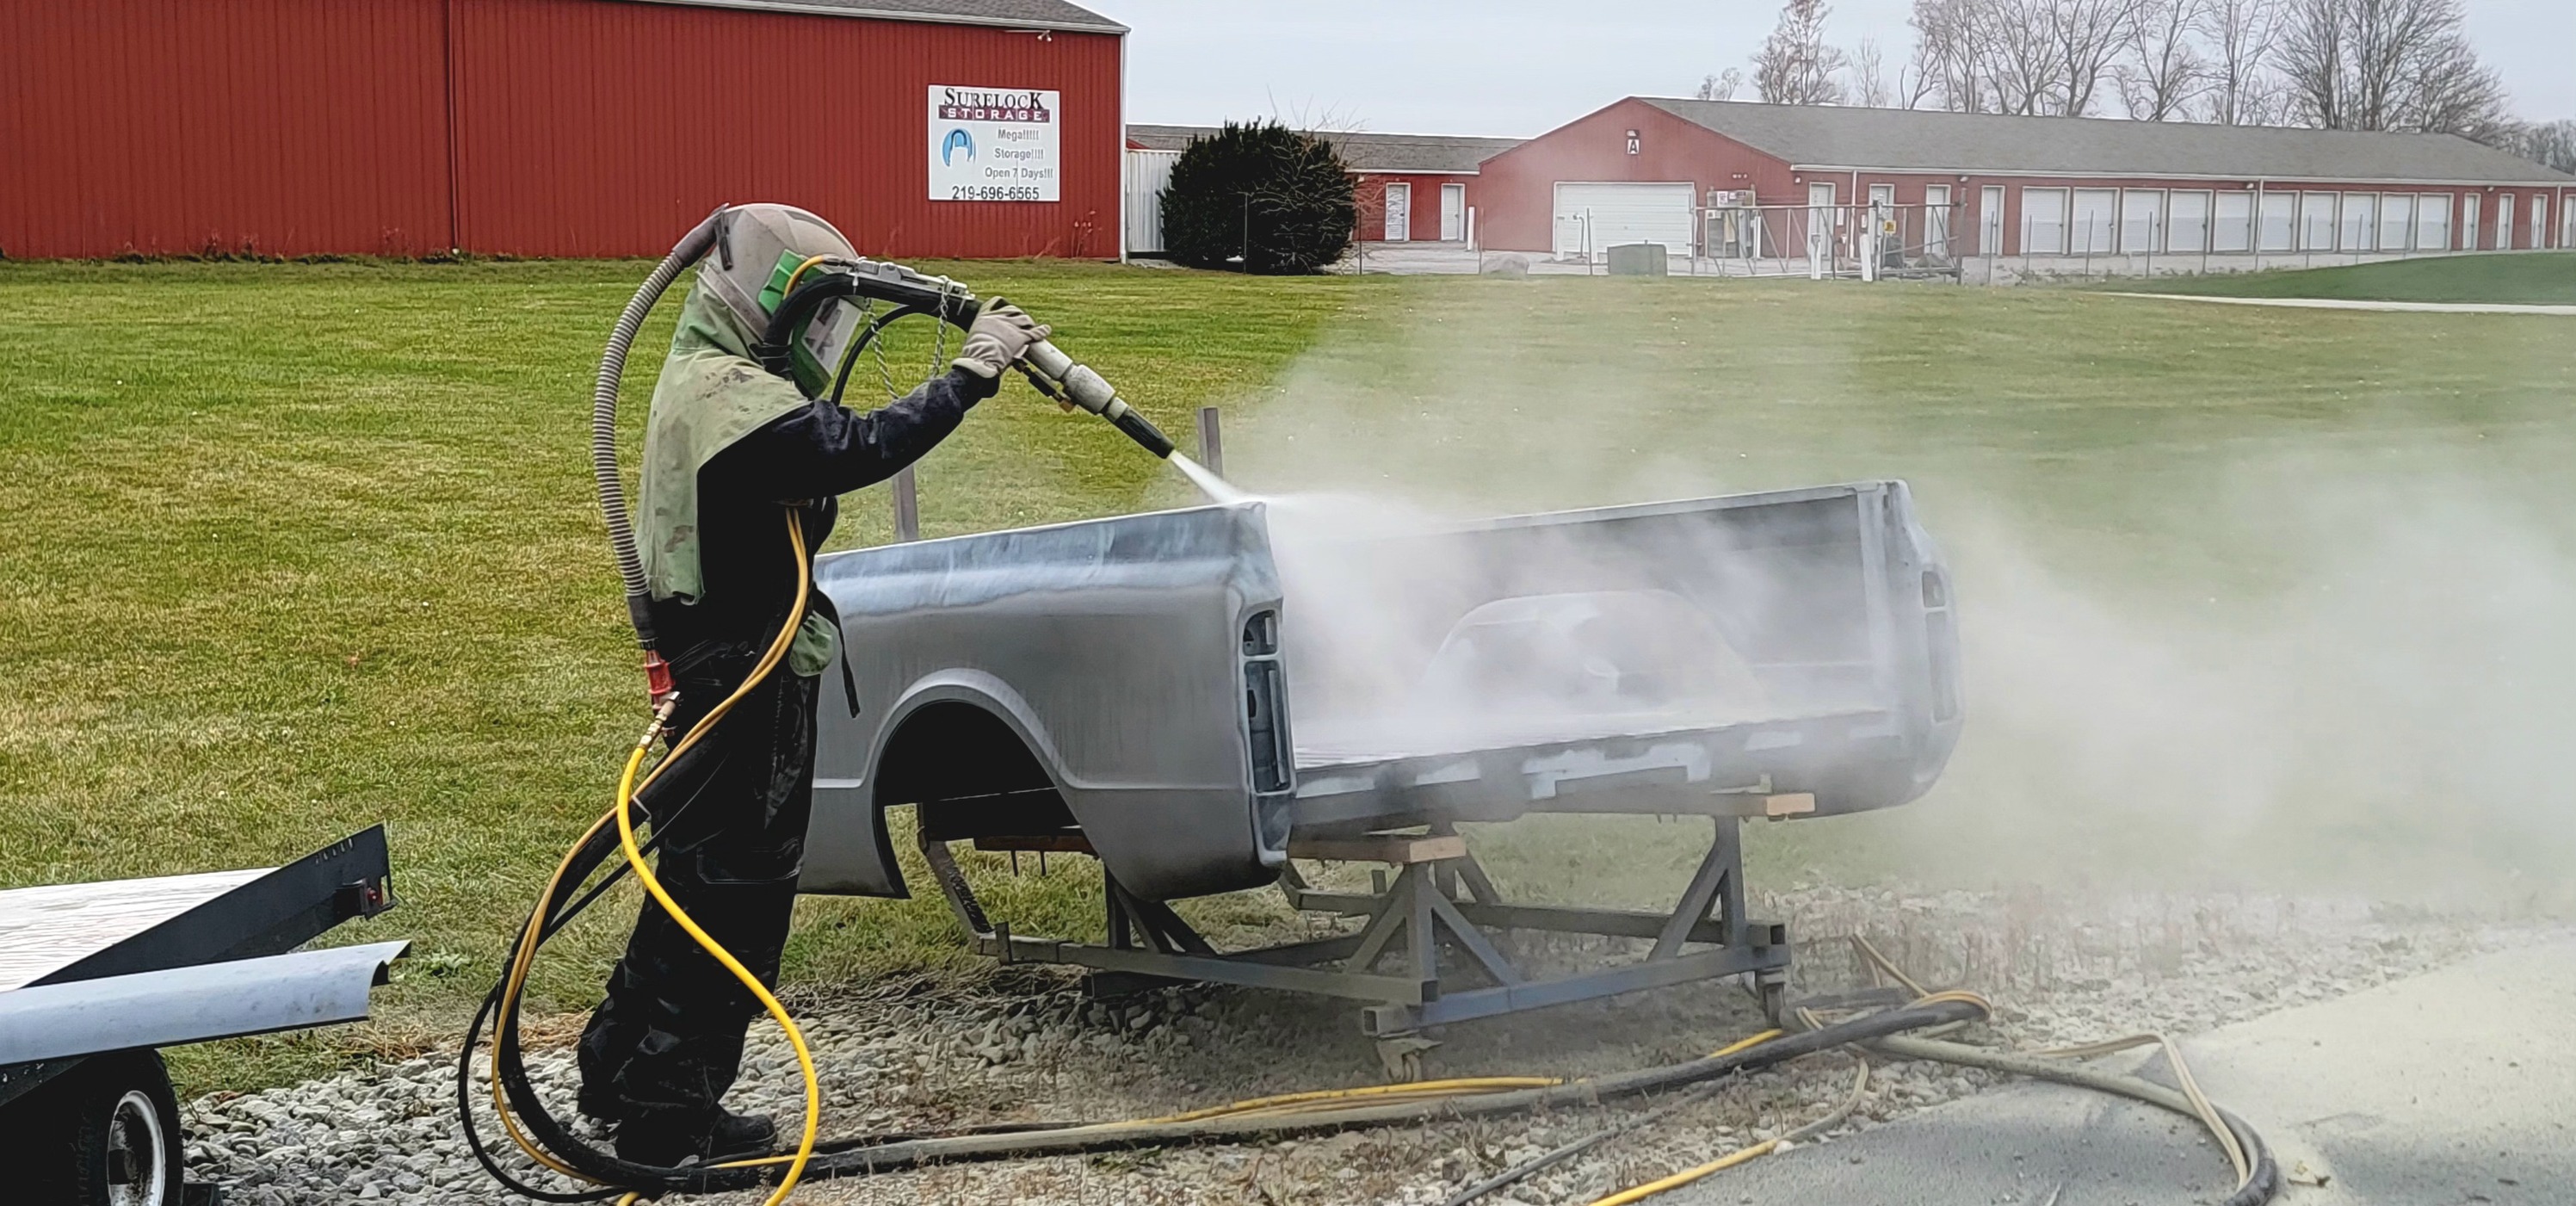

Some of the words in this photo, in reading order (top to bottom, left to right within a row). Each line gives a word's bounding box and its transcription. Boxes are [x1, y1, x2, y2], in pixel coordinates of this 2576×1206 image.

[945, 87, 1043, 109] SURELOCK
[948, 108, 1042, 121] STORAGE
[1629, 139, 1639, 153] A
[985, 167, 1010, 180] Open
[1013, 168, 1018, 178] 7
[1021, 168, 1053, 181] Days!!!
[952, 186, 1040, 200] 219-696-6565
